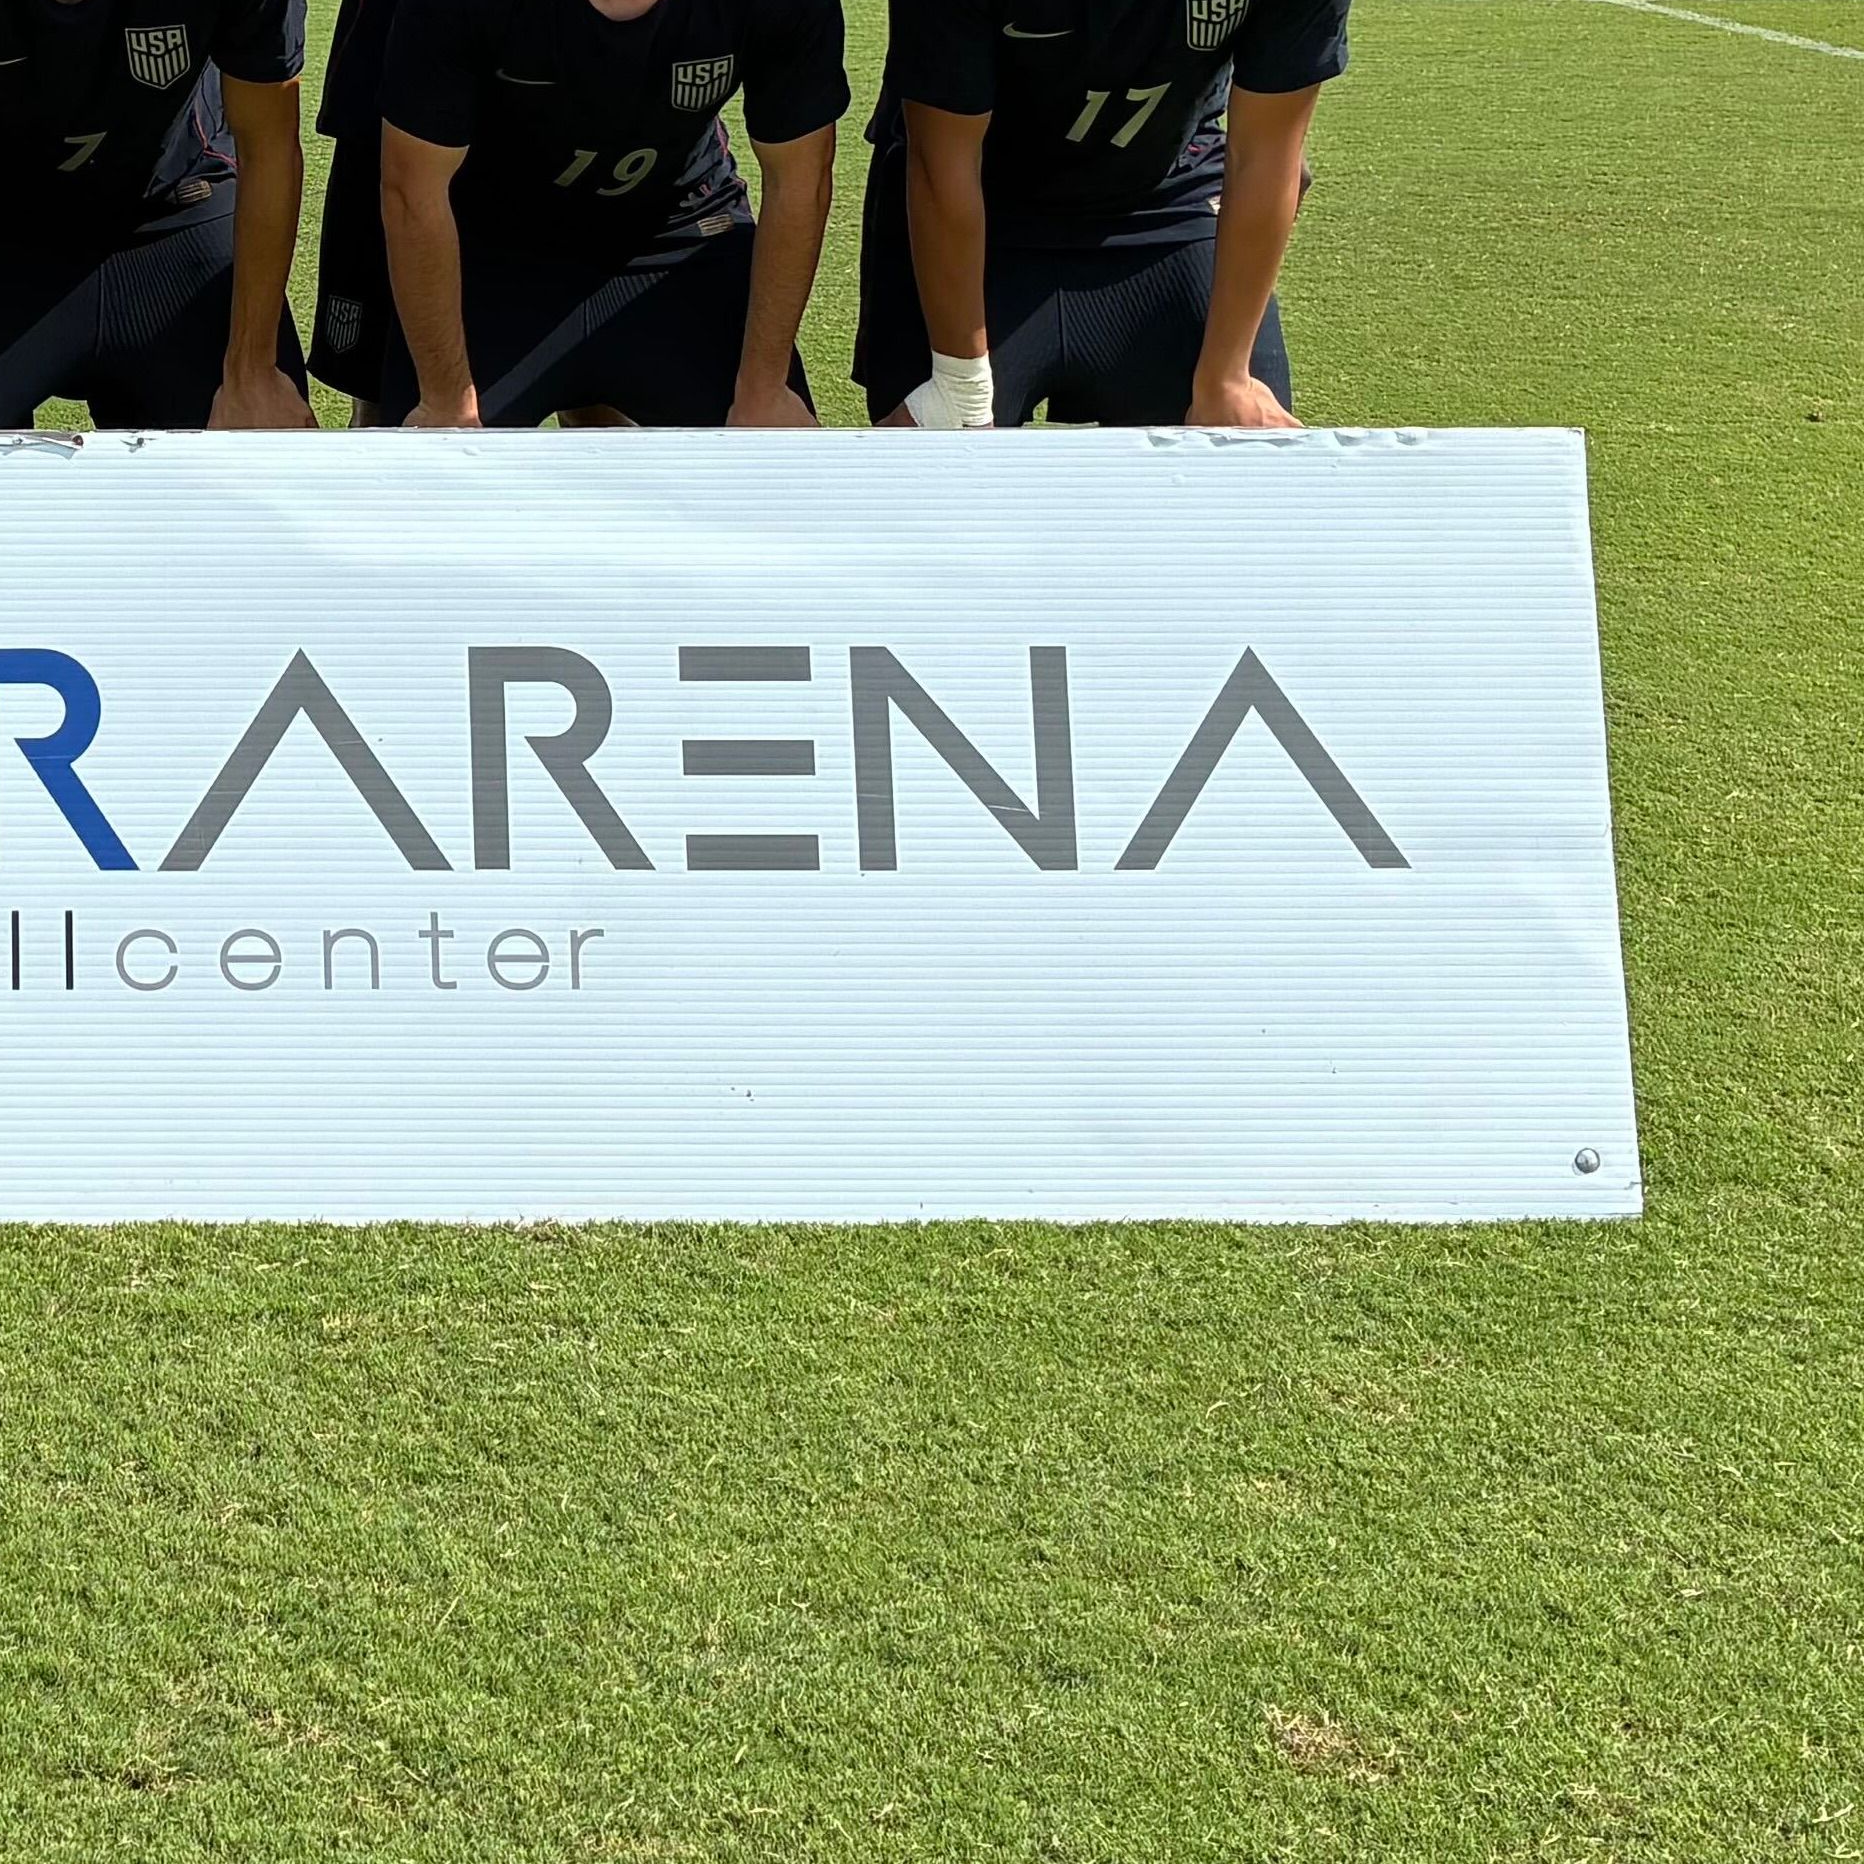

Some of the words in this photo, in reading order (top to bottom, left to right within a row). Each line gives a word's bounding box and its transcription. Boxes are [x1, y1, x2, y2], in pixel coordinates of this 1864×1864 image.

[131, 29, 183, 56] USA
[678, 59, 729, 85] USA
[1065, 82, 1172, 149] 17
[56, 132, 107, 172] 7
[554, 147, 659, 197] 19
